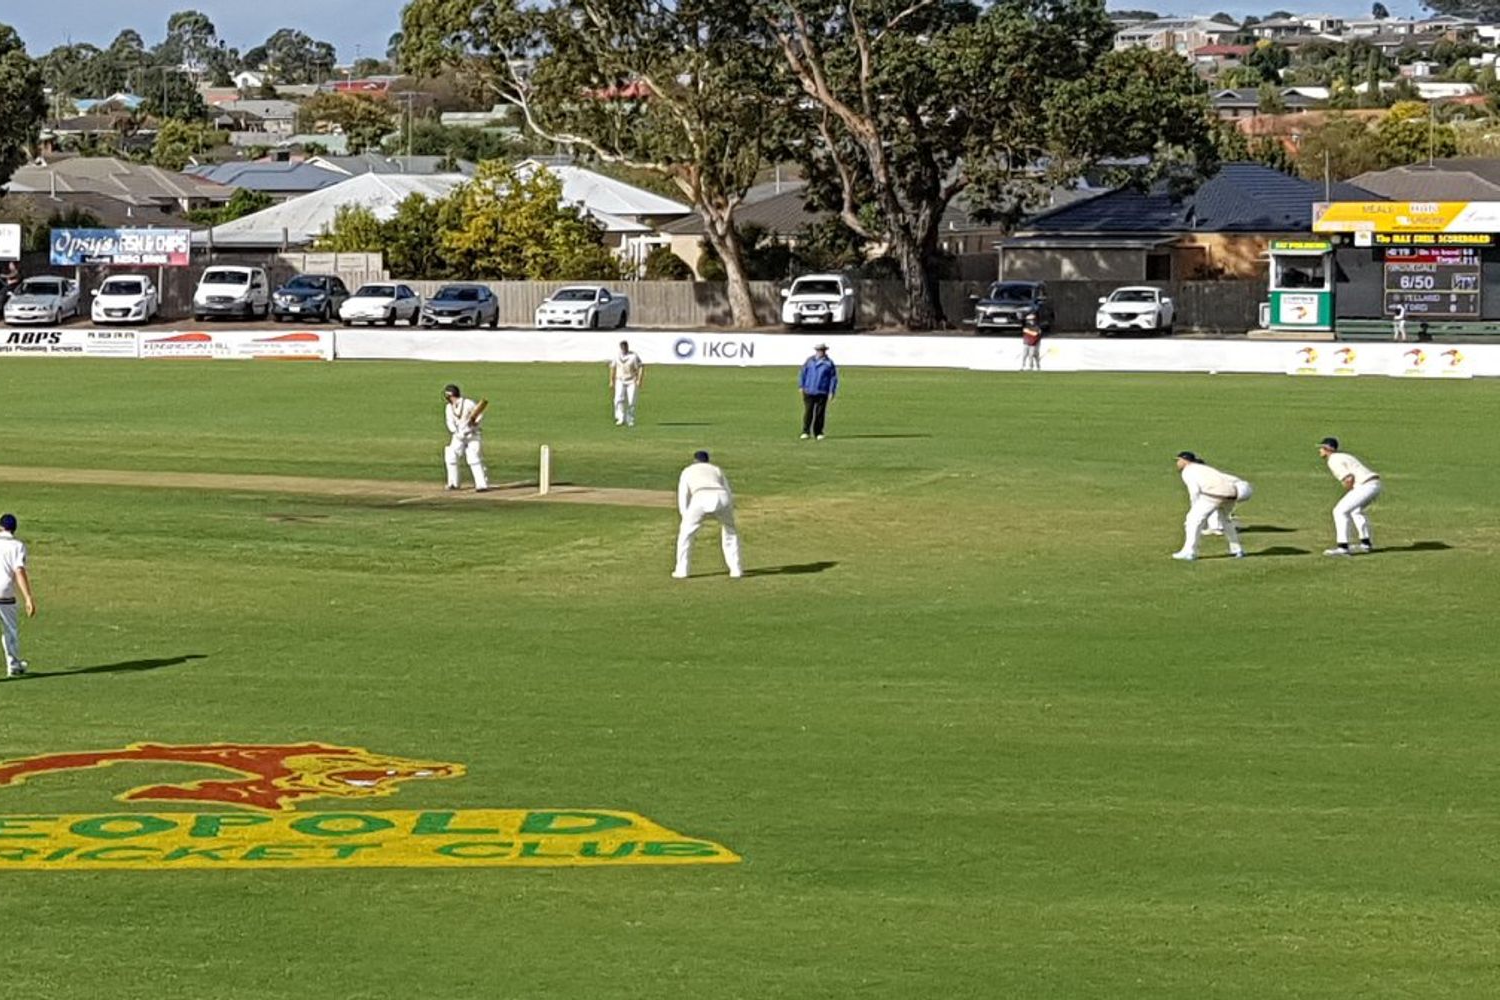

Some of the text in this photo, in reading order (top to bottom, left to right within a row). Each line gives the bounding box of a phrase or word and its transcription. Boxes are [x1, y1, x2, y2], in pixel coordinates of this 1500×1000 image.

[1401, 276, 1434, 289] 6/50
[7, 332, 62, 344] ABPS
[702, 341, 755, 359] IKON
[437, 840, 721, 859] CLUB
